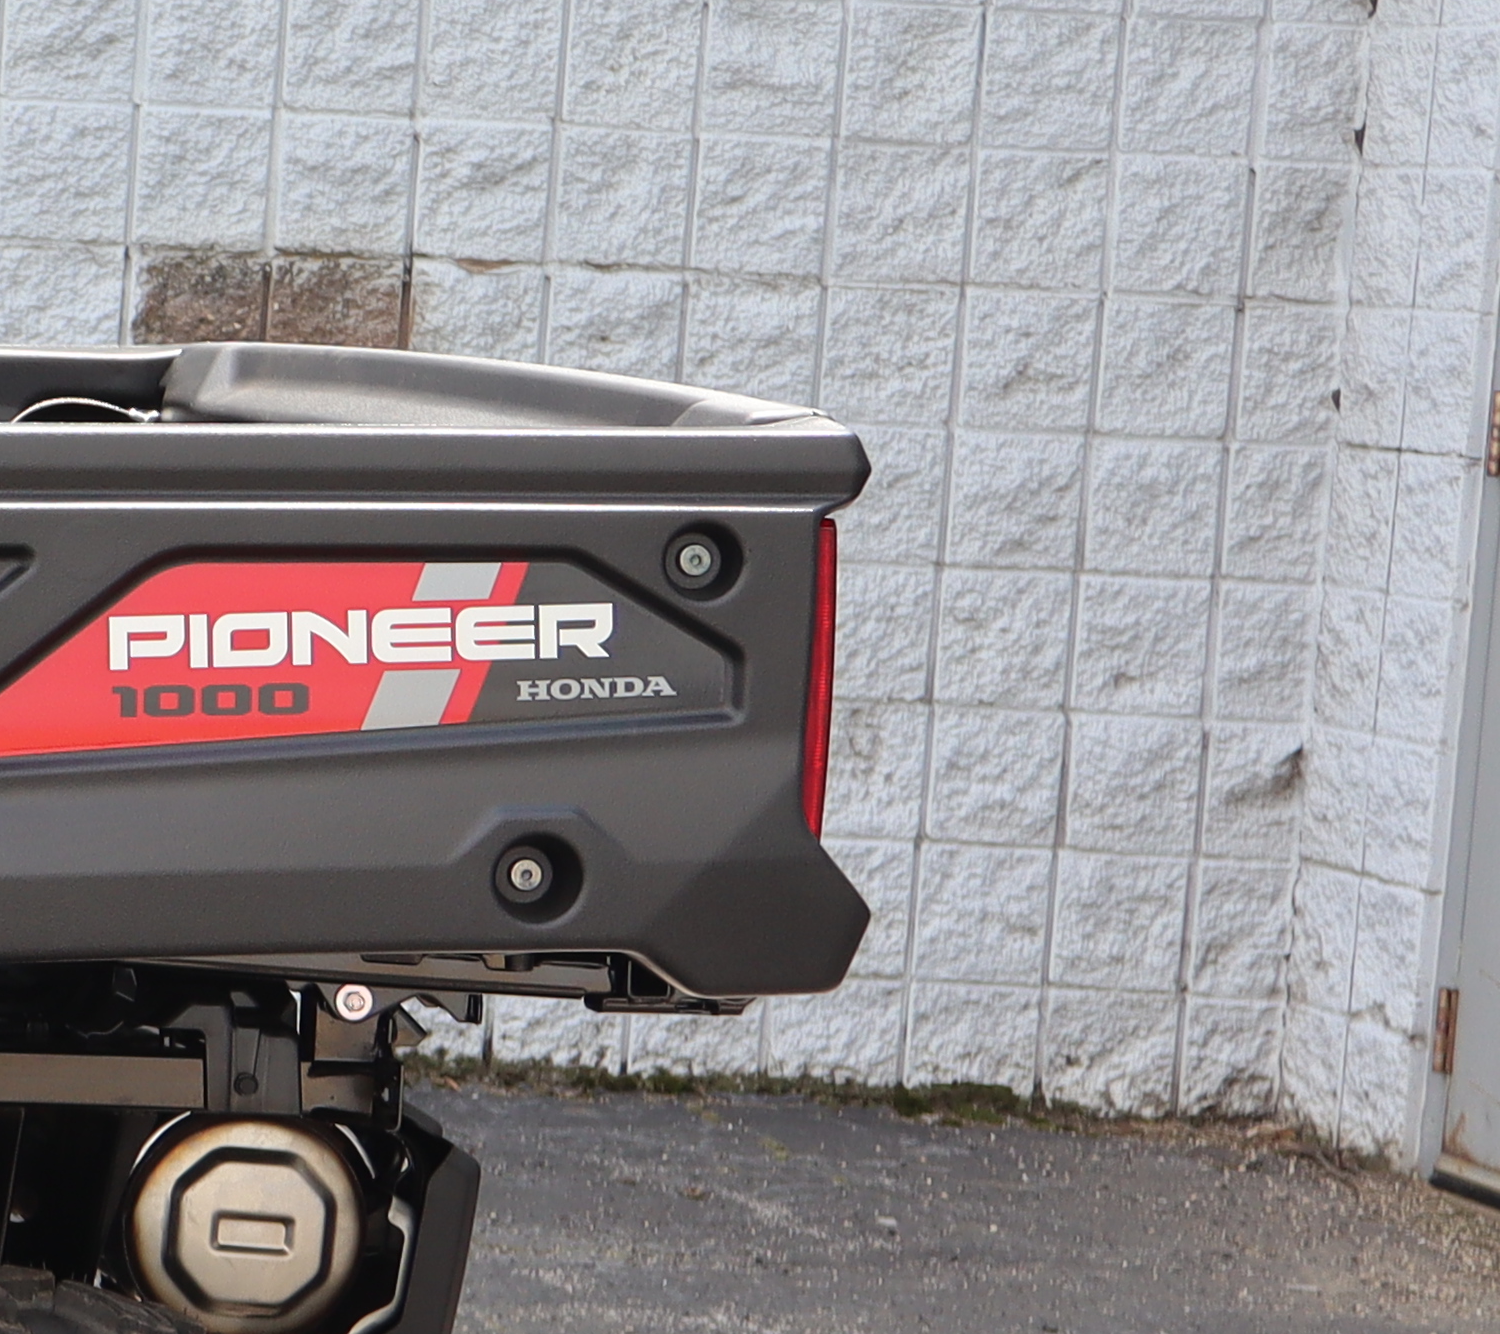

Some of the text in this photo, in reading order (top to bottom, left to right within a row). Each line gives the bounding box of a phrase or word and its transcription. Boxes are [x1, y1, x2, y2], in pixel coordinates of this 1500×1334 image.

[108, 602, 614, 671] PIONEER
[111, 682, 310, 718] 1000
[515, 675, 678, 702] HONDA
